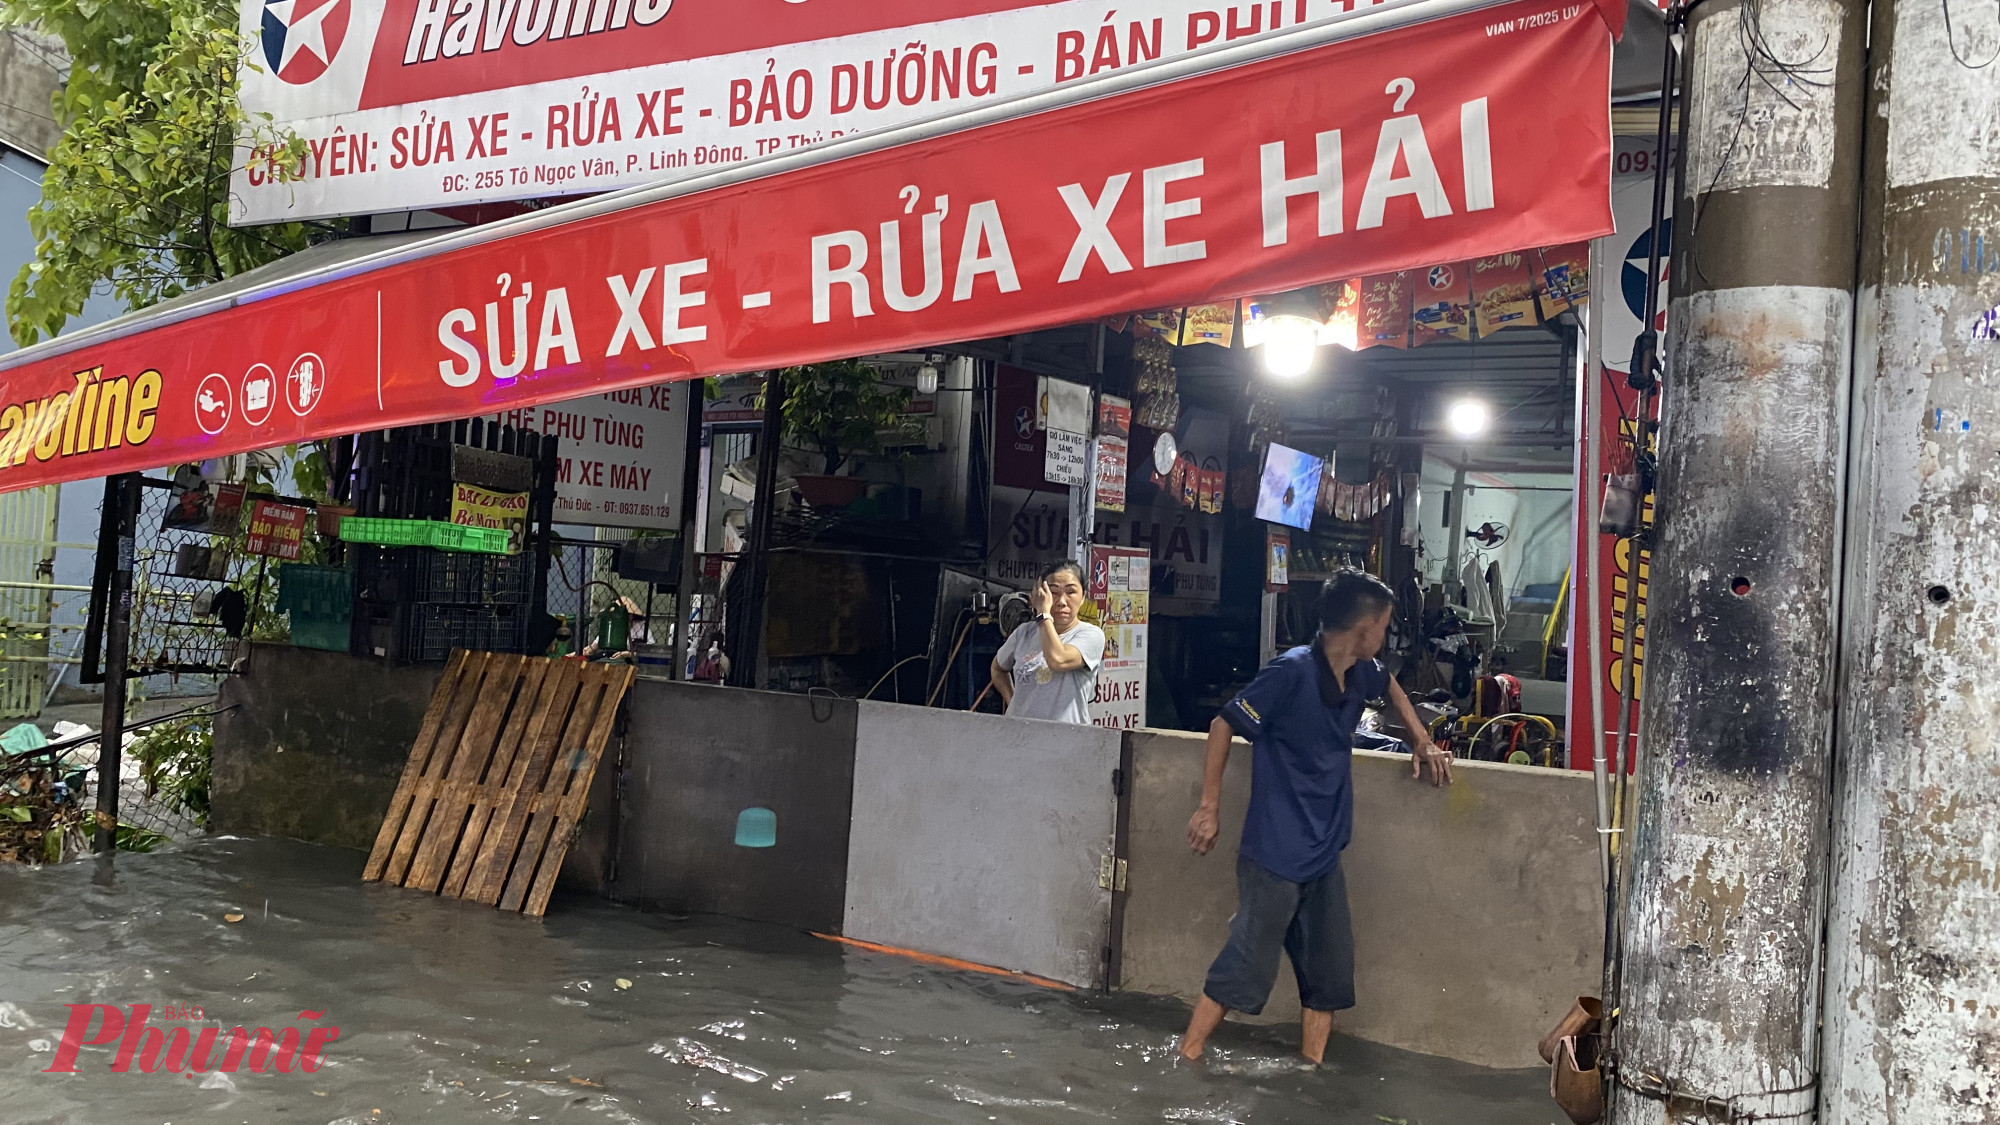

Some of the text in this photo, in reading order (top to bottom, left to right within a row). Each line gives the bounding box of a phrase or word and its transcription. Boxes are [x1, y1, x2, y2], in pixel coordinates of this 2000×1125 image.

[1485, 4, 1580, 37] VIAN 7/2025 UV
[248, 126, 378, 187] CHUYÊN:
[390, 109, 452, 170] SỬA
[466, 112, 509, 159] XE
[521, 131, 533, 141] -
[546, 85, 622, 150] RỬA
[635, 87, 685, 140] XE
[699, 107, 712, 118] -
[728, 57, 814, 128] BẢO
[830, 40, 998, 115] DƯỠNG
[1017, 64, 1034, 76] -
[1055, 10, 1163, 84] BÁN
[442, 174, 469, 193] ĐC:
[475, 170, 504, 190] 255
[510, 167, 529, 185] Tô
[534, 162, 576, 185] Ngọc
[582, 157, 619, 177] Vân,
[626, 154, 643, 173] P.
[649, 149, 688, 171] Linh
[438, 77, 1495, 386] SỬA XE - RỬA XE HẢI
[647, 385, 671, 412] XE
[543, 409, 586, 447] PHỤ
[592, 413, 644, 449] TÙNG
[1046, 451, 1060, 461] 7h30
[1068, 455, 1084, 464] 12h00
[1058, 442, 1073, 454] SÁNG
[578, 460, 603, 487] XE
[610, 461, 652, 491] MÁY
[604, 501, 618, 514] ĐT:
[619, 504, 670, 518] 0937.851.129
[252, 518, 300, 541] BẢO HIỂM
[1131, 514, 1210, 564] HẢI
[280, 540, 299, 559] MÁY
[1094, 677, 1140, 704] SỬA XE
